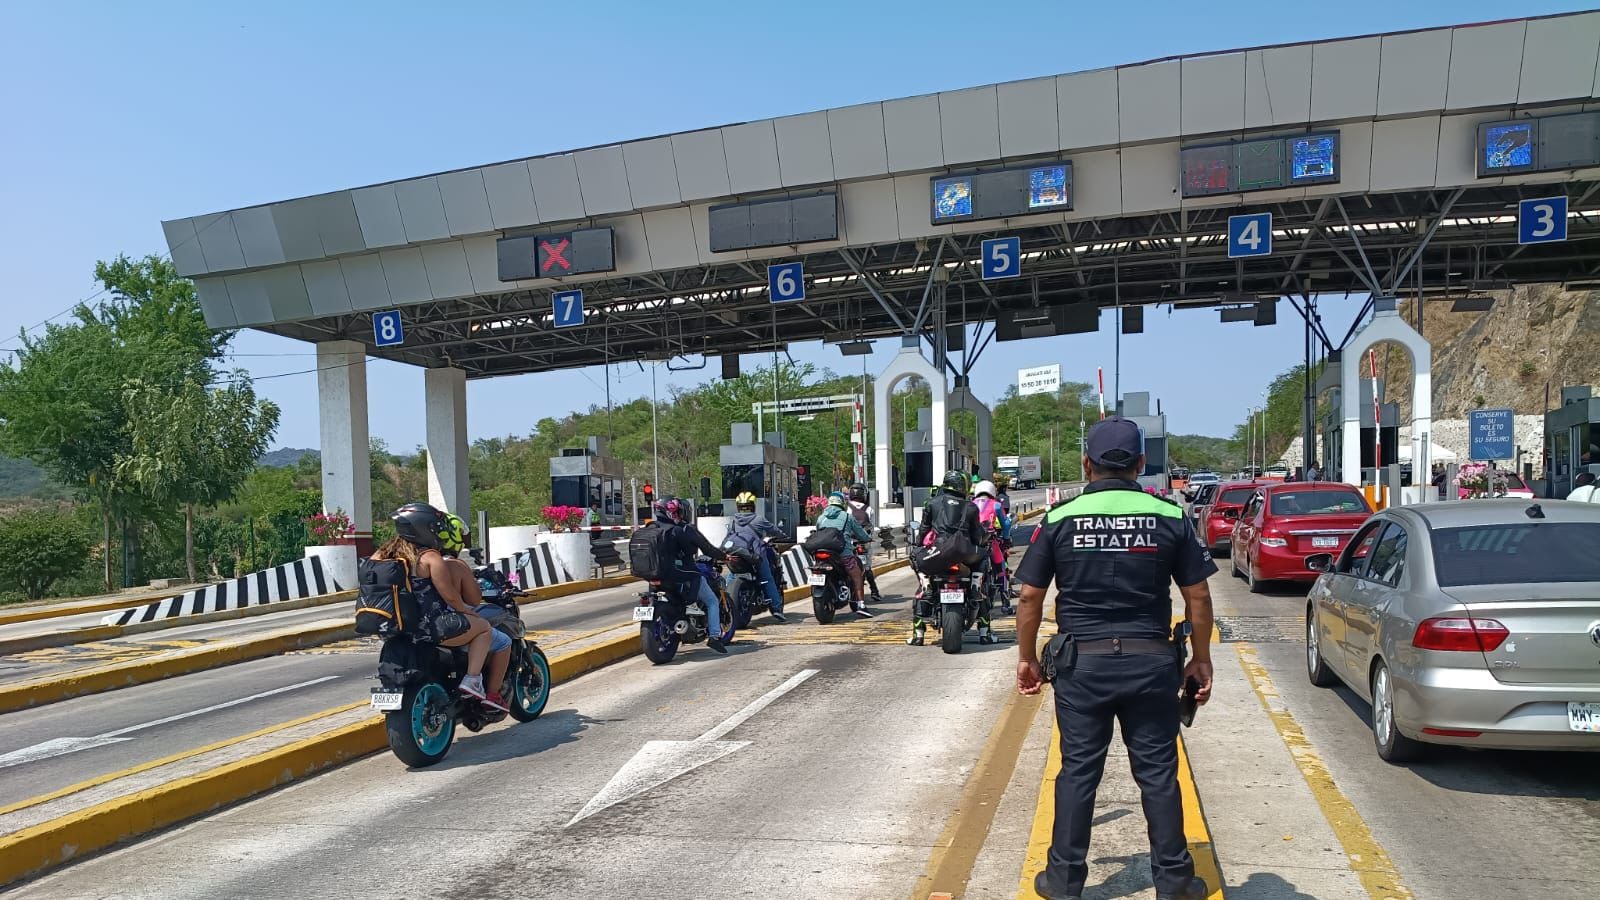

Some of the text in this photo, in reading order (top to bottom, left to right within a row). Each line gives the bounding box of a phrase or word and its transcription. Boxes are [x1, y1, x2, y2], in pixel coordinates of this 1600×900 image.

[1533, 205, 1555, 237] 3
[1238, 220, 1261, 250] 4
[991, 243, 1011, 273] 5
[776, 268, 796, 297] 6
[560, 295, 575, 321] 7
[381, 316, 396, 340] 8
[1475, 411, 1507, 419] CONSERVE
[1479, 423, 1504, 431] BOLETO
[1474, 435, 1509, 444] SU SEGURO
[1073, 516, 1156, 531] TRANSITO
[1072, 534, 1158, 548] ESTATAL
